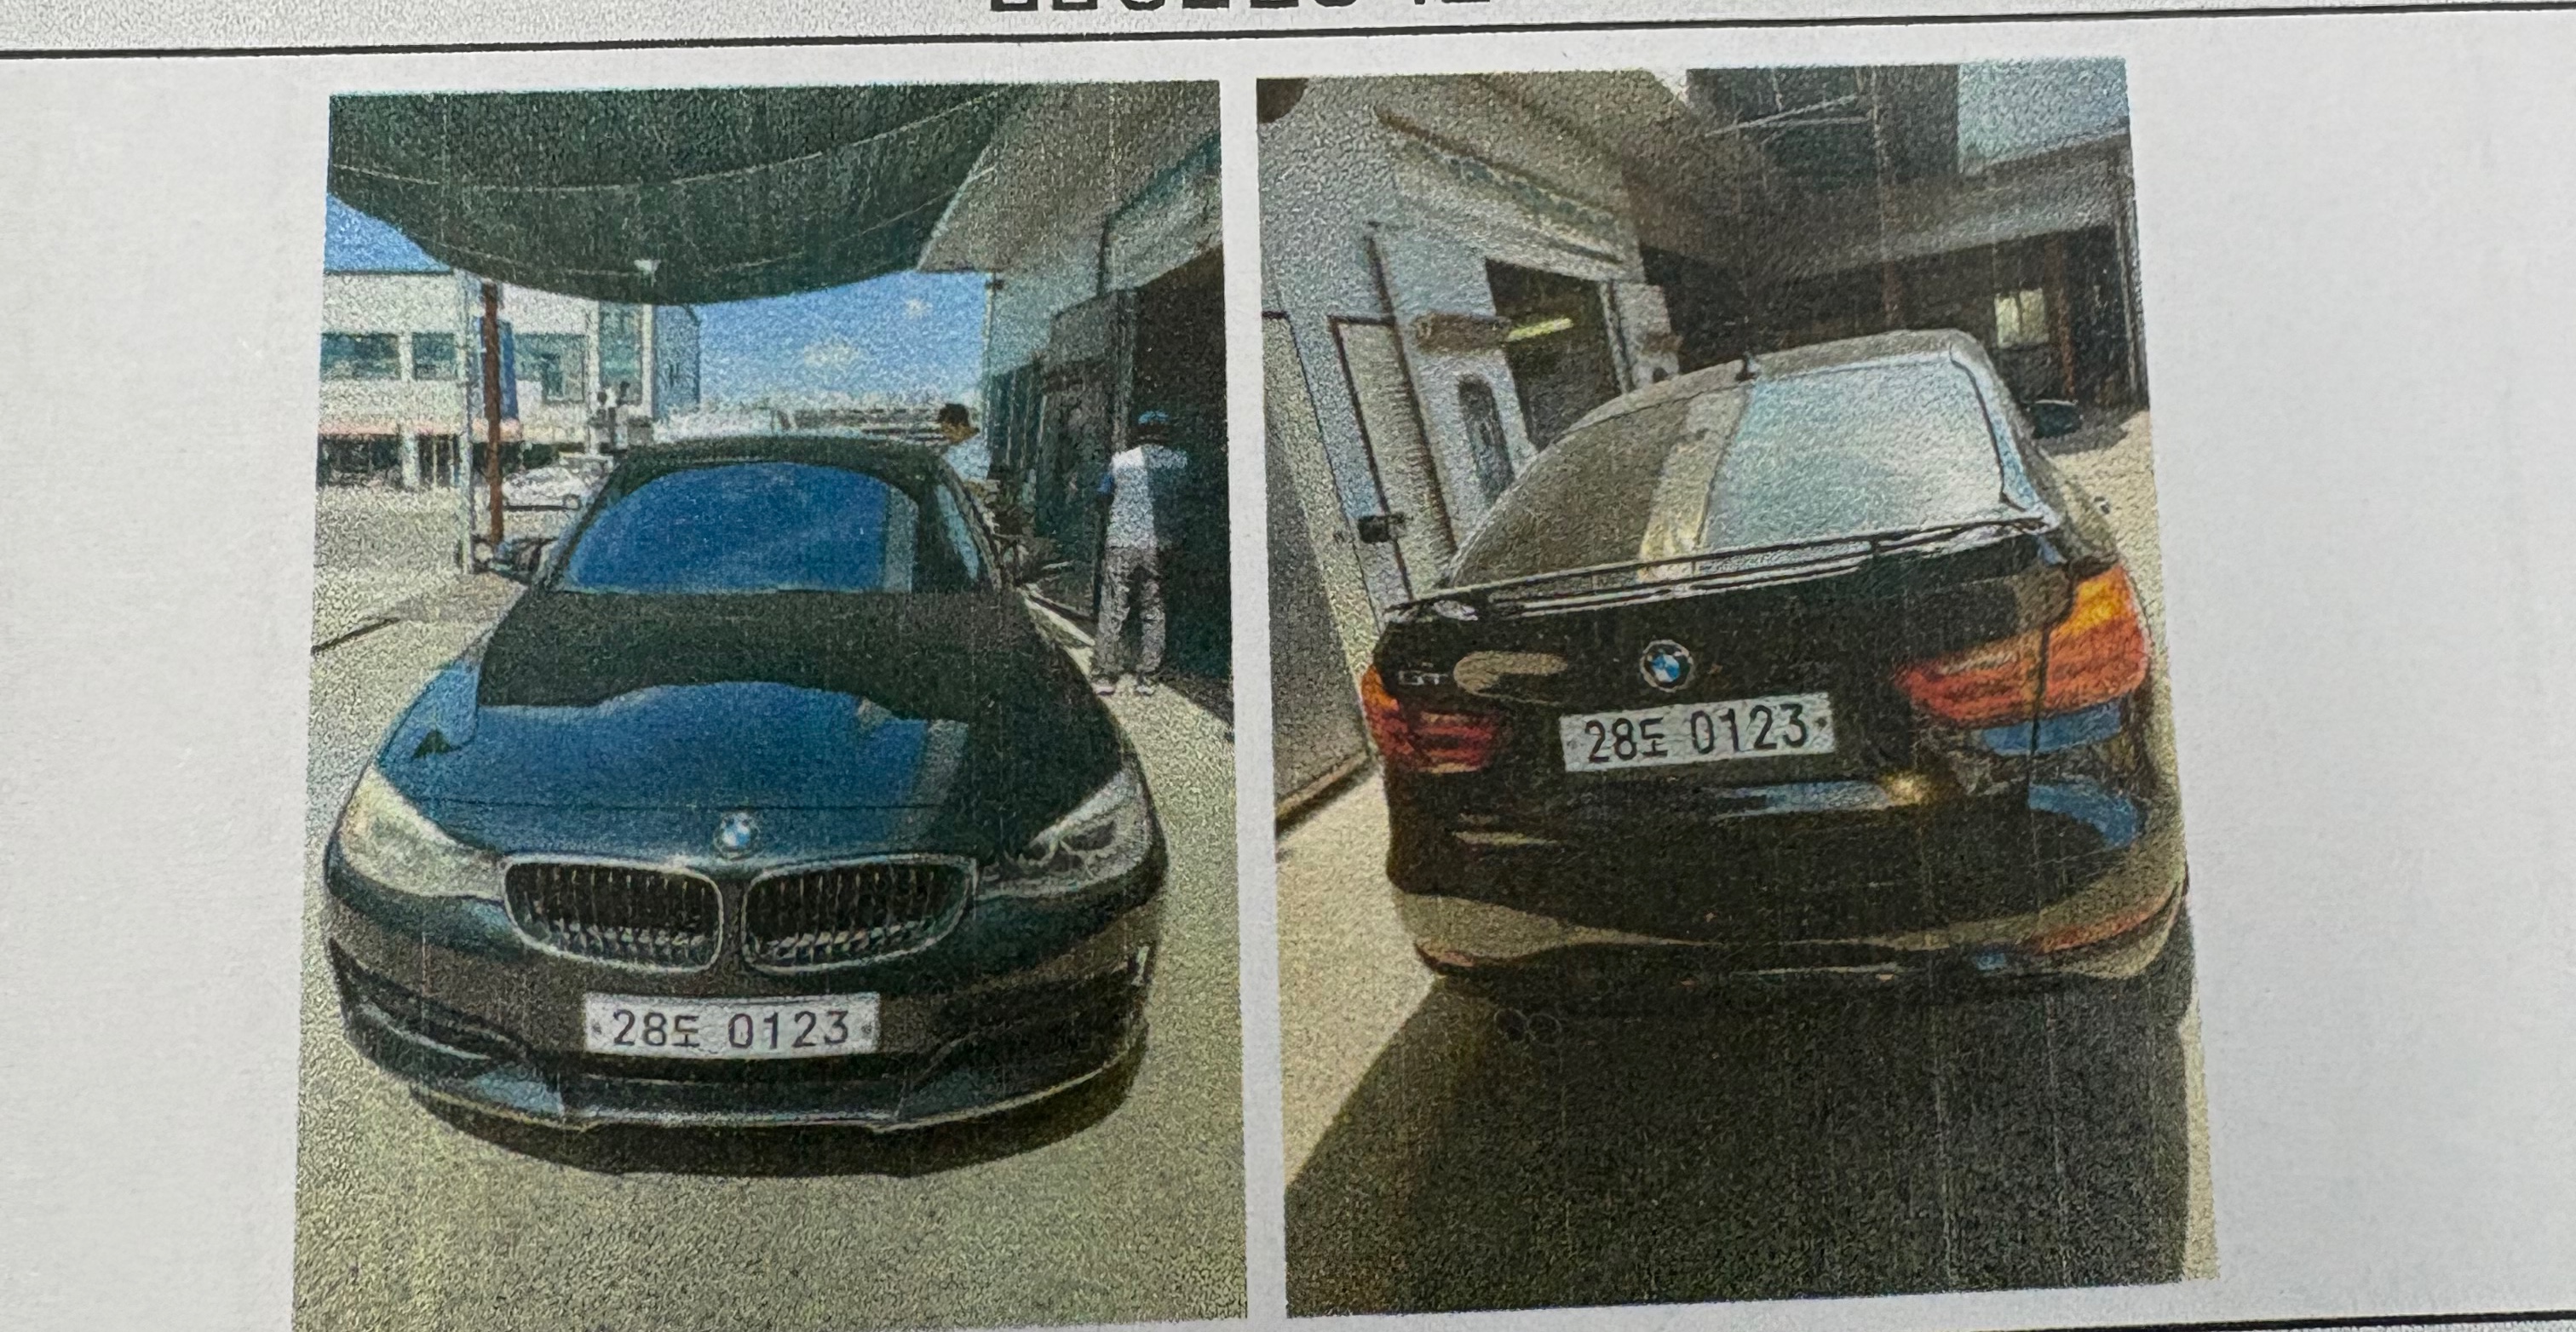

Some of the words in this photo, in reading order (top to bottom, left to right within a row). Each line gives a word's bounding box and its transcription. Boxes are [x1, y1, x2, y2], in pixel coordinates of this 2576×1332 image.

[1584, 717, 1667, 762] 28도
[1691, 703, 1808, 755] 0123
[613, 1008, 700, 1048] 28도
[727, 1010, 849, 1049] 0123
